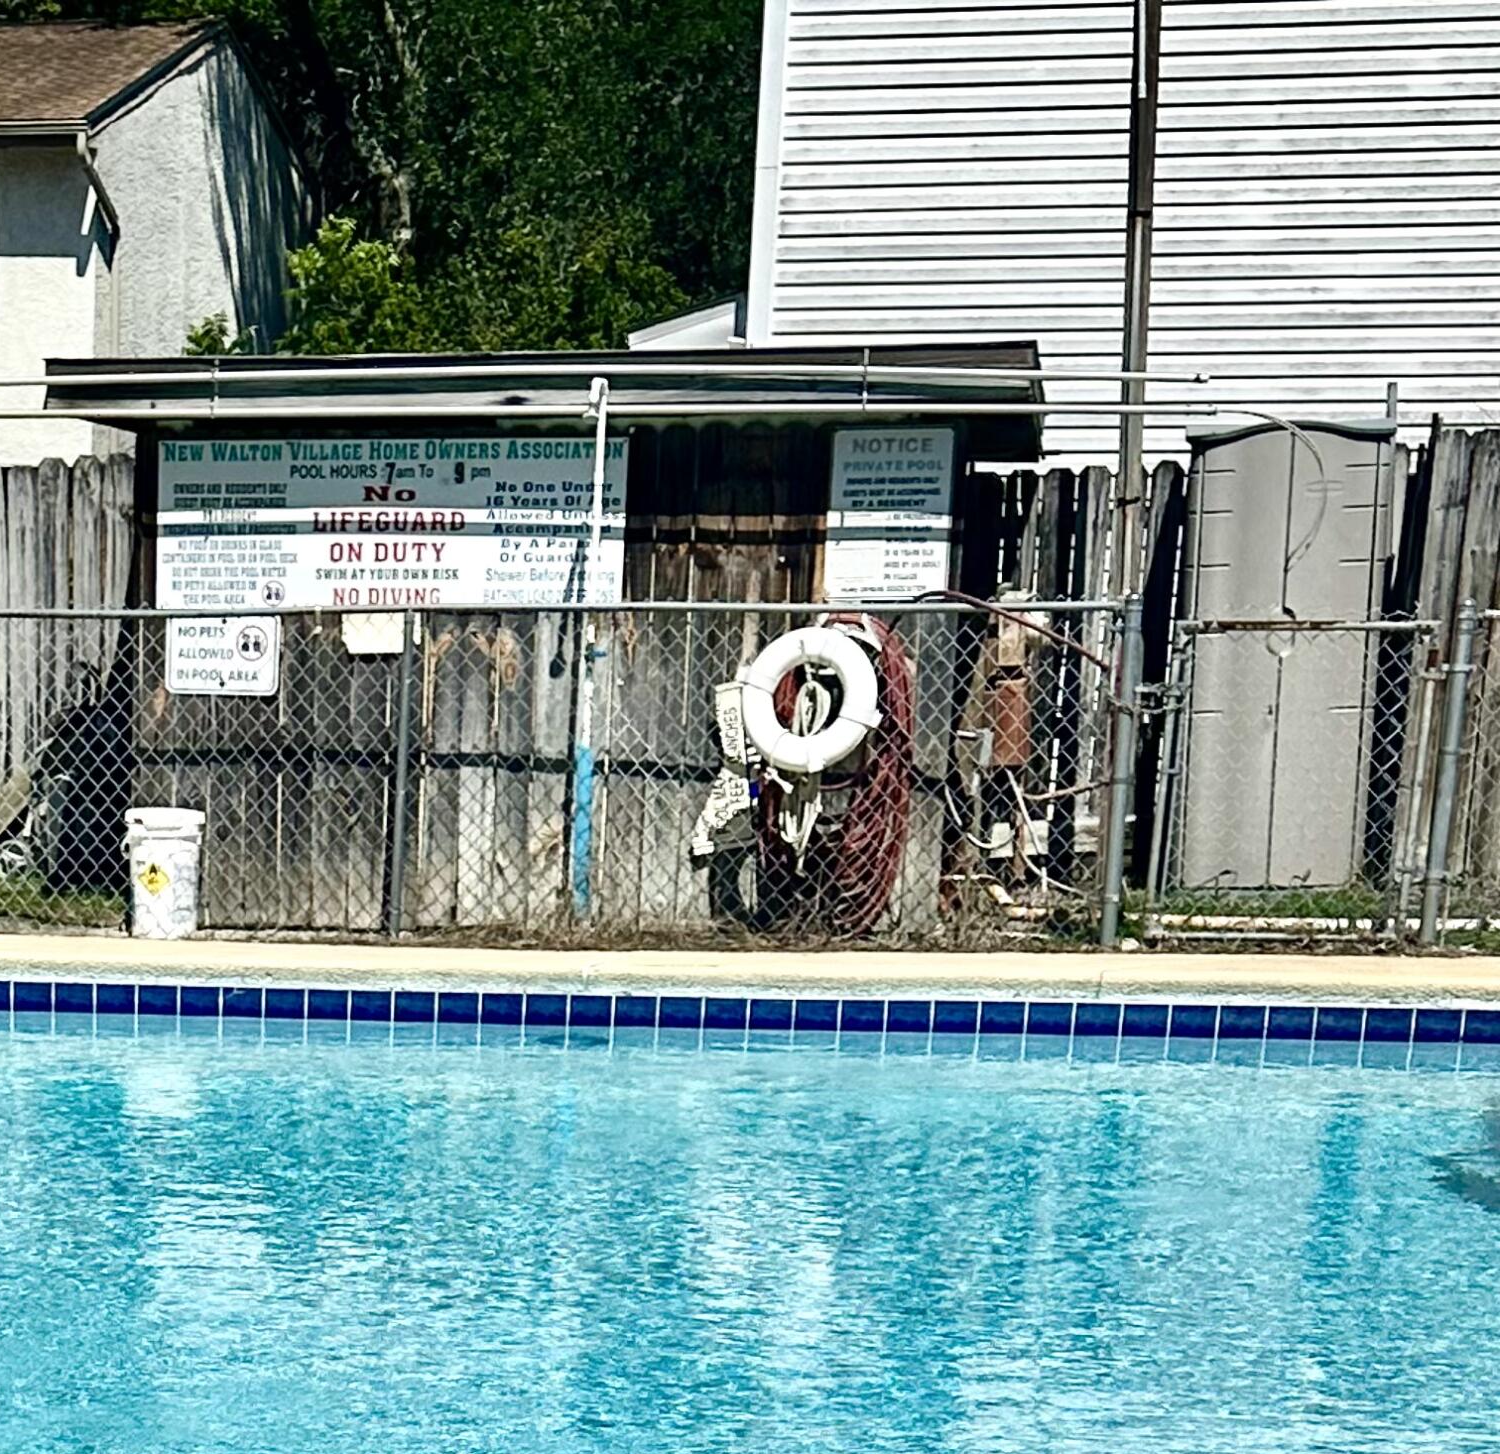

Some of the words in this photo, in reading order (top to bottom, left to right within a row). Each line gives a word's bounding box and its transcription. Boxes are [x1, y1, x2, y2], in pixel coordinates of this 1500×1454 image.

[506, 440, 623, 460] ASSOCIATON
[852, 438, 933, 454] NOTICE
[843, 460, 904, 472] PRIVATE
[907, 459, 944, 471] POOL
[290, 465, 326, 479] POOL
[330, 464, 377, 479] HOURS
[454, 462, 465, 484] 9
[495, 481, 517, 493] No
[523, 481, 556, 493] One
[511, 496, 558, 507] Years
[486, 508, 554, 520] Allowed
[313, 512, 466, 532] LIFEGUARD
[529, 539, 539, 548] A
[330, 542, 363, 562] ON
[374, 542, 445, 562] DUTY
[500, 553, 516, 563] Or
[316, 568, 347, 580] SWIM
[351, 568, 366, 580] AT
[370, 568, 399, 580] YOUR
[403, 568, 428, 580] OWN
[433, 568, 459, 580] RISK
[333, 588, 359, 605] NO
[368, 588, 440, 605] DIVING
[178, 626, 196, 638] NO
[200, 626, 226, 638] PETS
[178, 648, 234, 660] ALLOWED
[177, 669, 190, 680] IN
[192, 668, 222, 681] POOL
[228, 670, 259, 681] AREA
